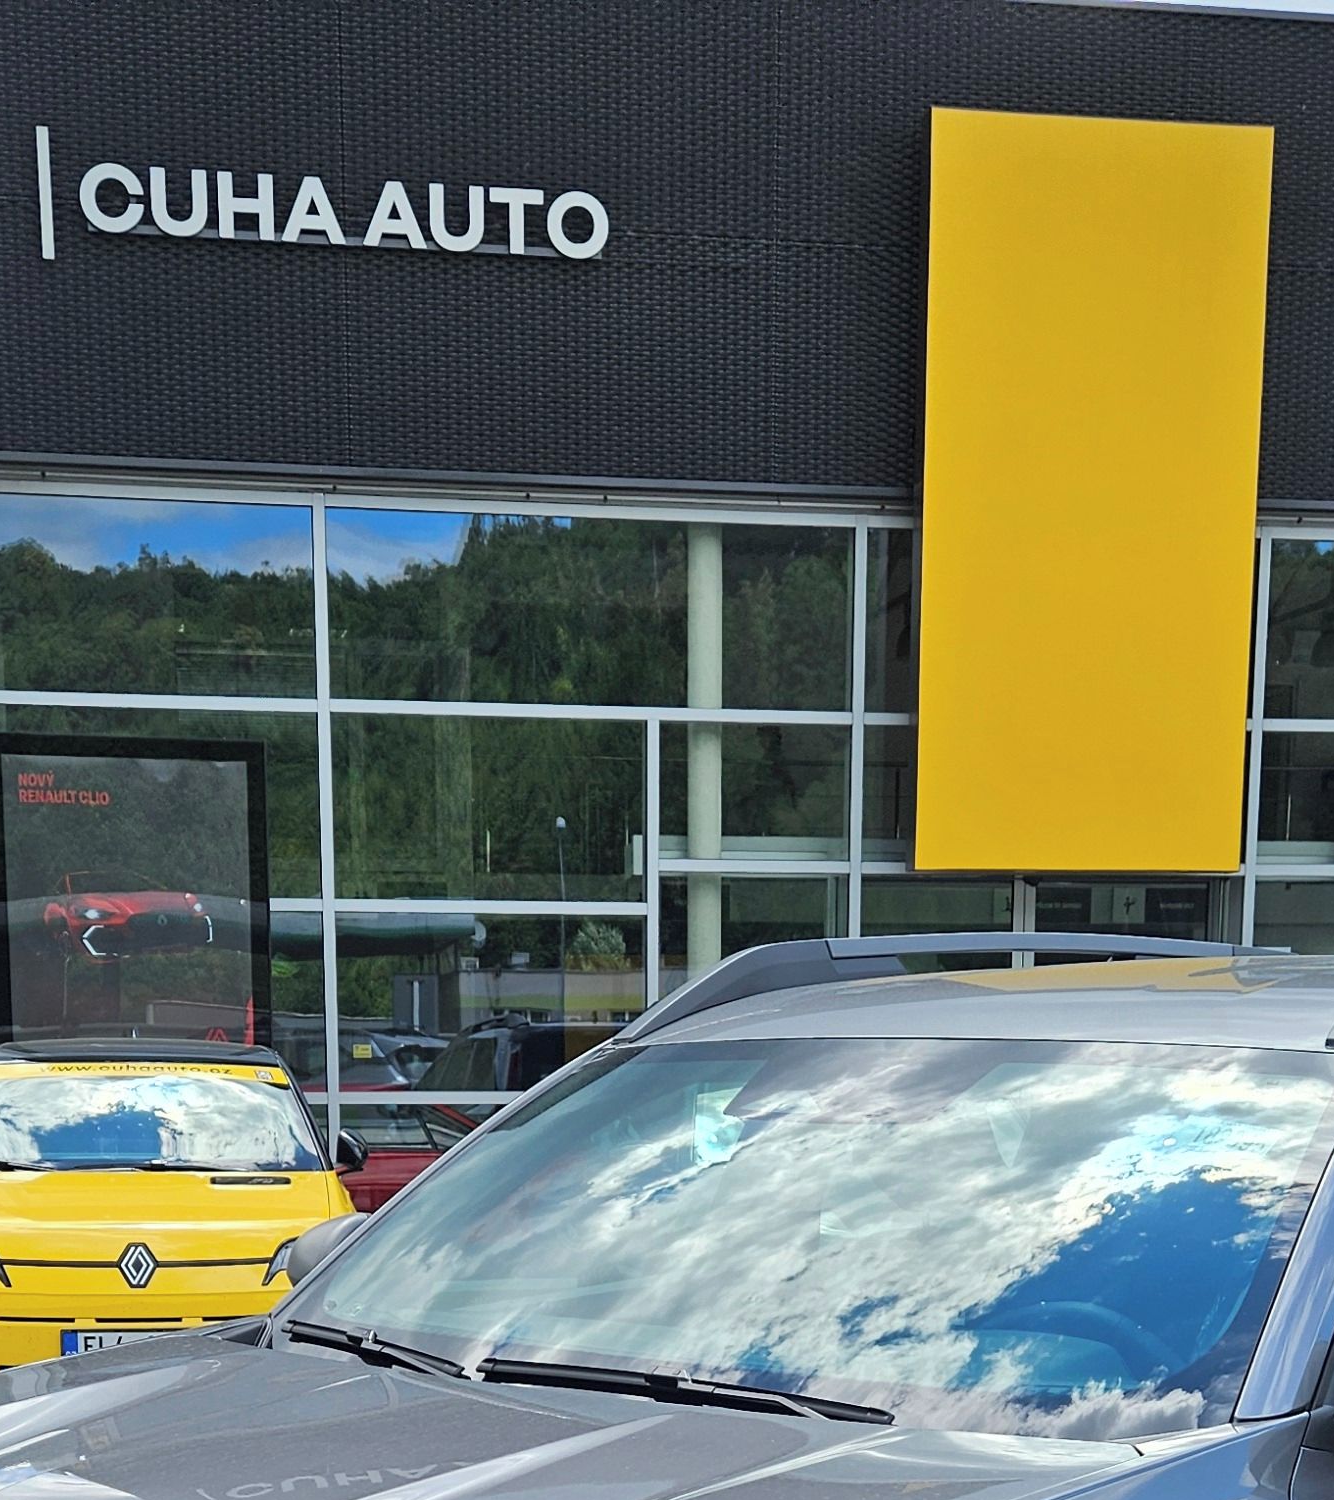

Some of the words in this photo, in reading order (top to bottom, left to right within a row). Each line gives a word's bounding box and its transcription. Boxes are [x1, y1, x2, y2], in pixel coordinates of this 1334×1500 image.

[78, 161, 346, 245] CUHA
[362, 180, 610, 260] AUTO
[18, 770, 55, 787] NOVÝ
[18, 789, 77, 804] RENAULT
[79, 791, 111, 806] CLIO
